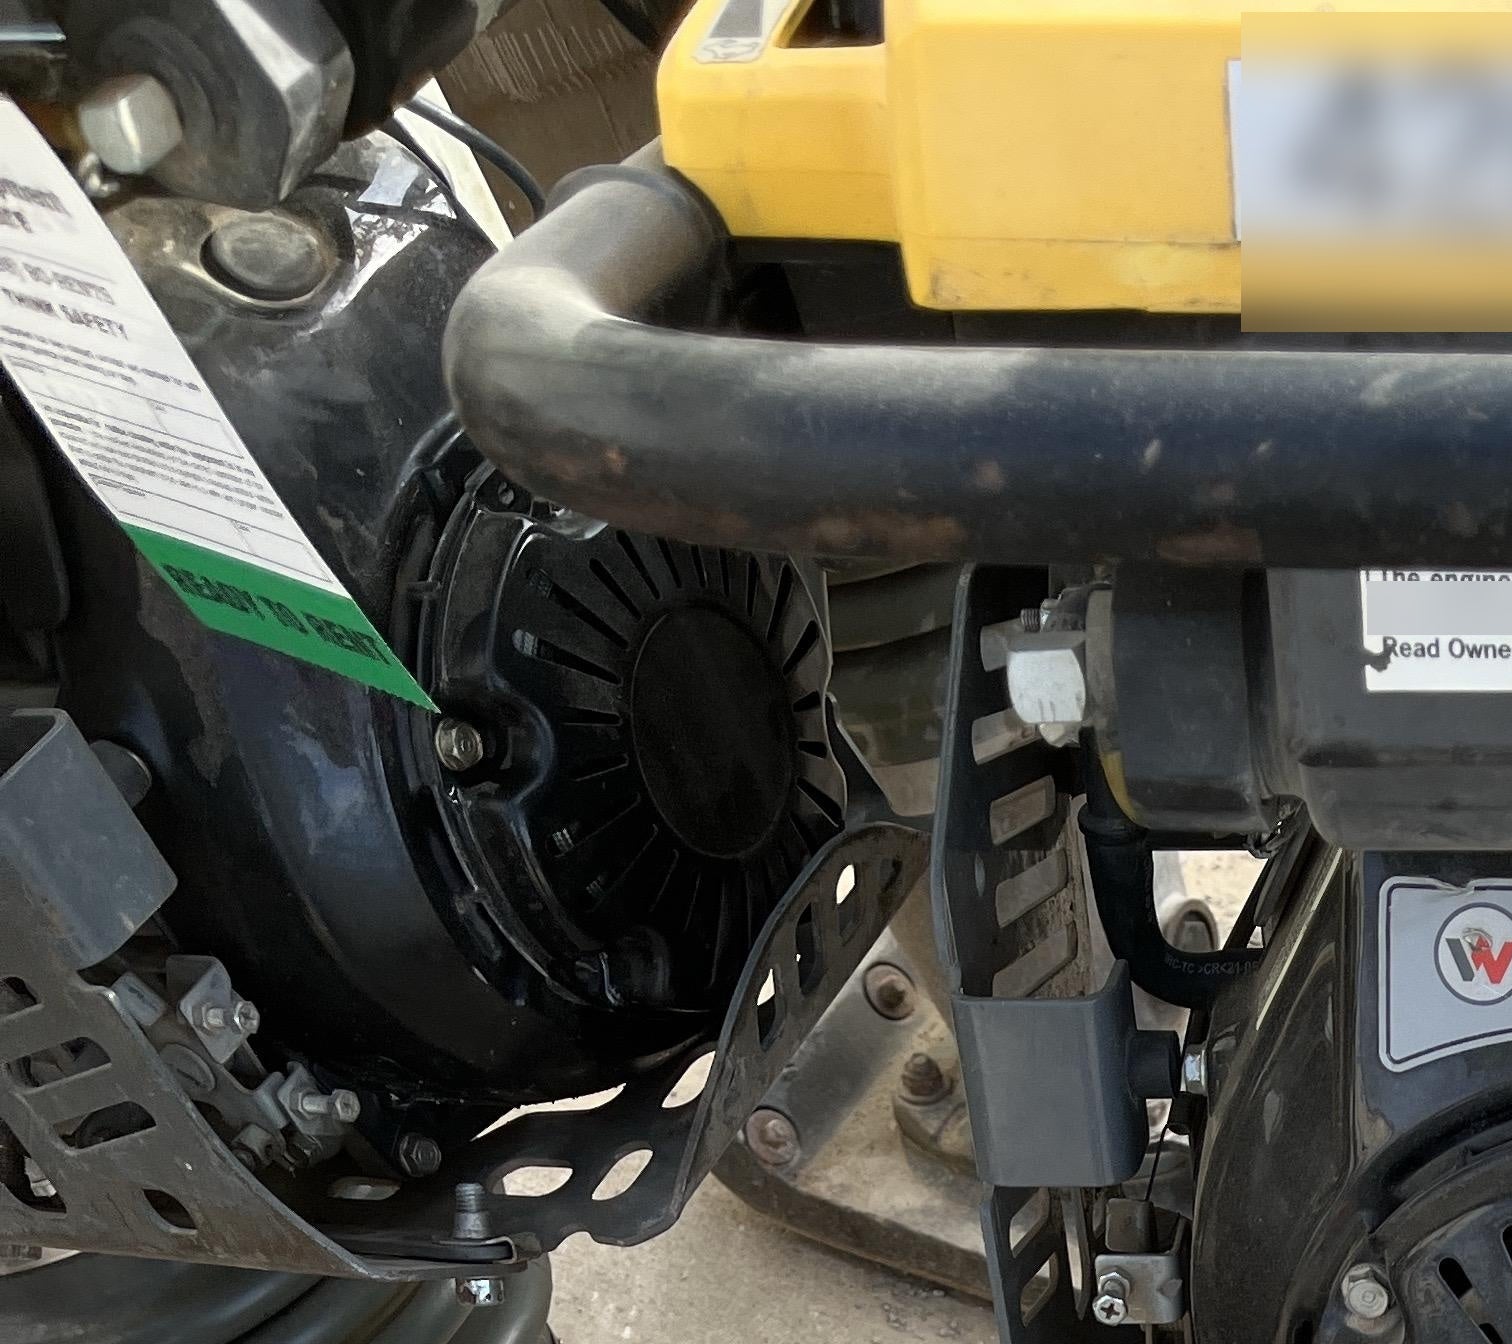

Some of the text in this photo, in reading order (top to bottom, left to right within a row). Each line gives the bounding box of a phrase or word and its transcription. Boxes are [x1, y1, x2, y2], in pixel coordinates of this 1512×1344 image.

[161, 563, 392, 669] READY TO RENT
[1382, 636, 1440, 659] Read
